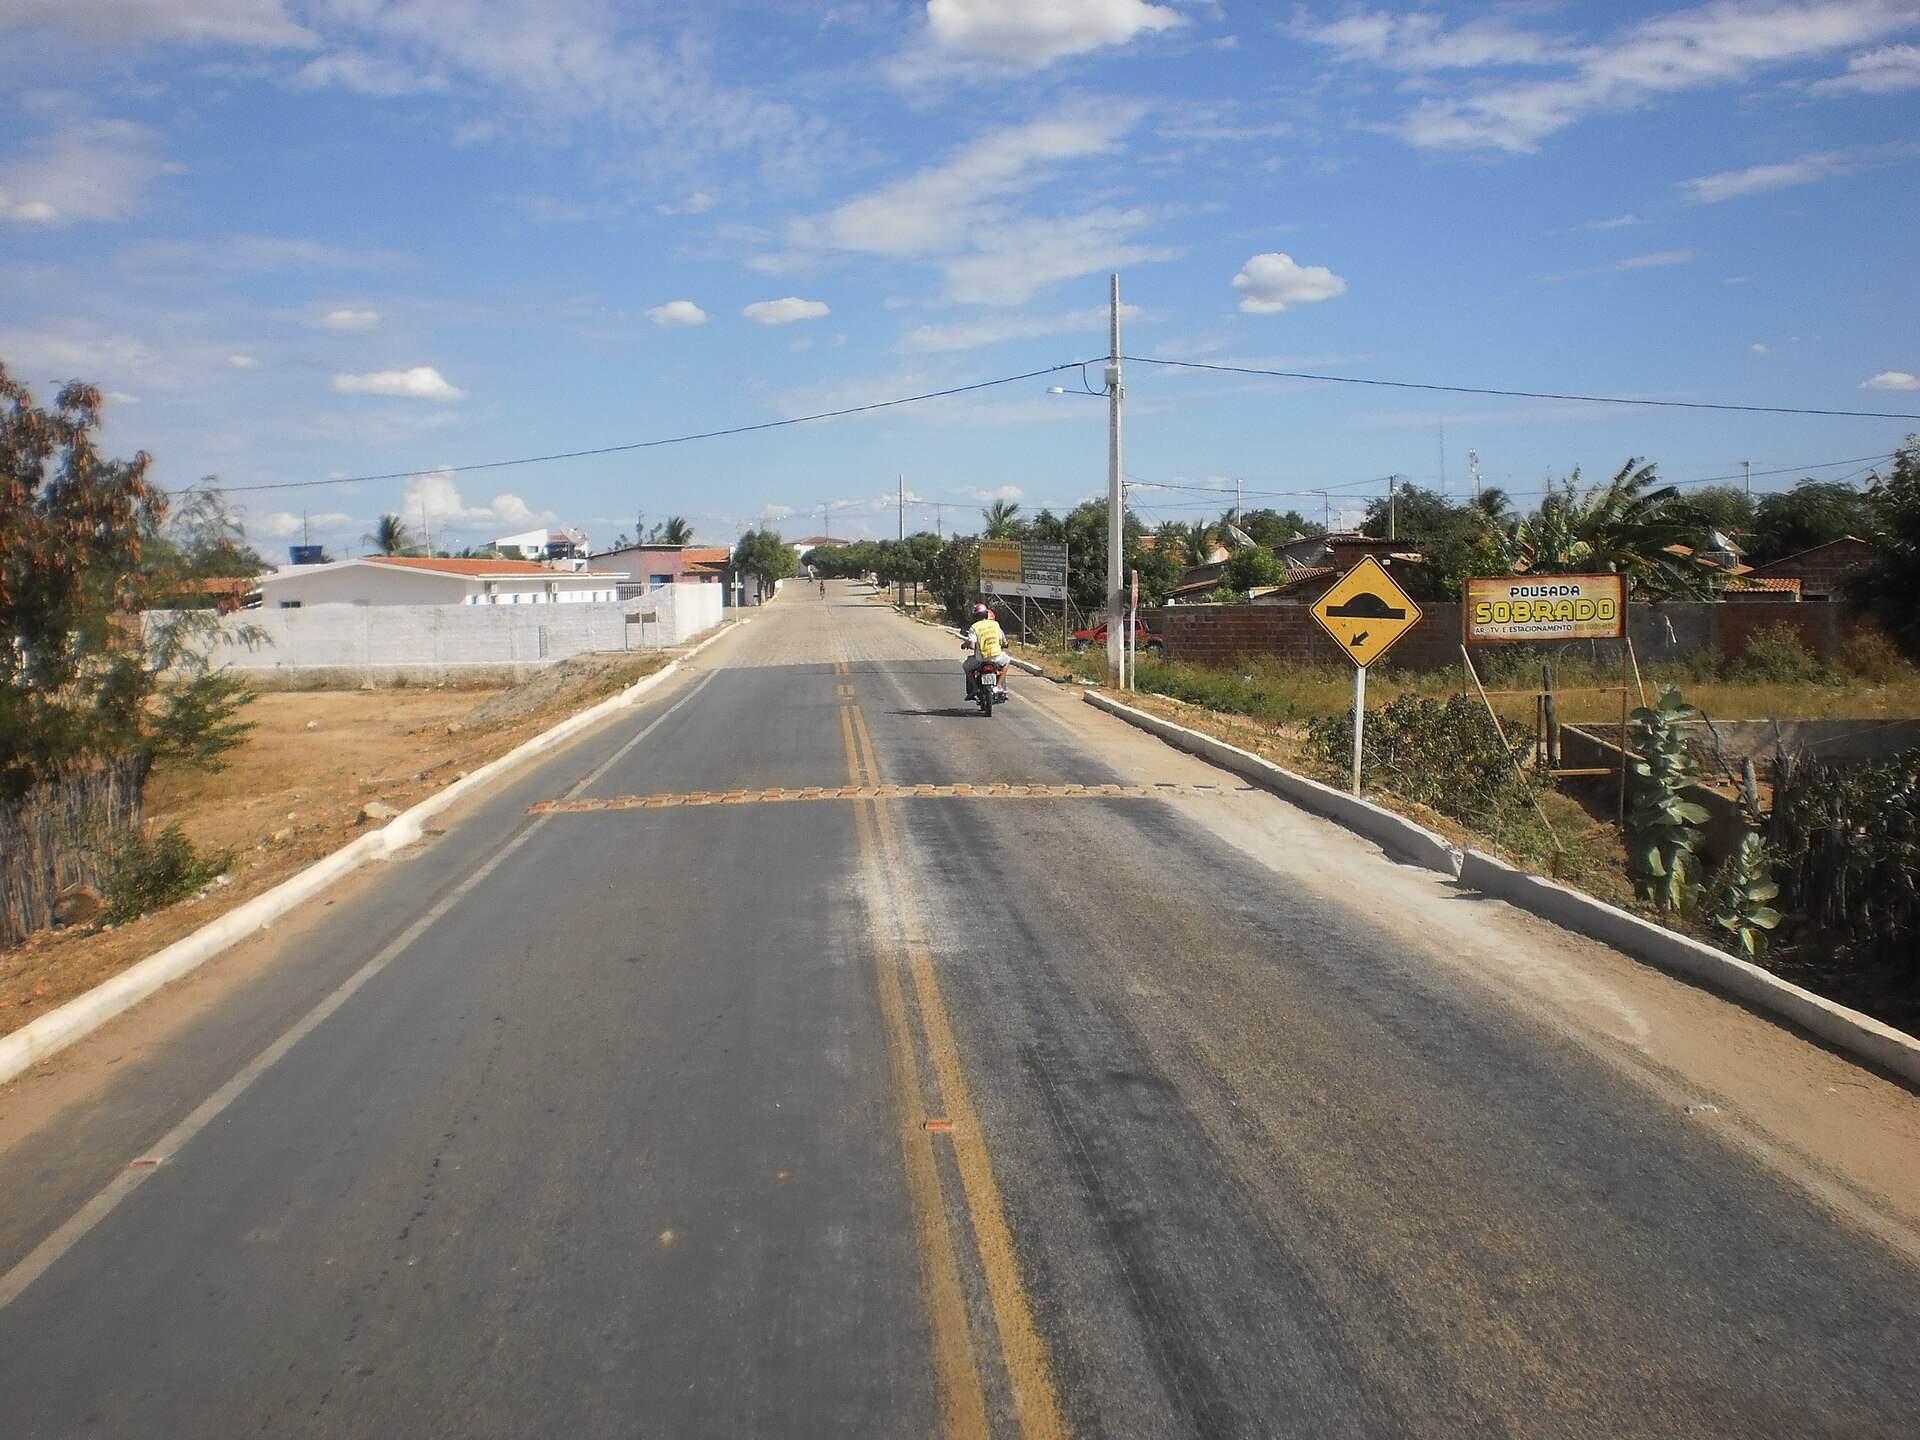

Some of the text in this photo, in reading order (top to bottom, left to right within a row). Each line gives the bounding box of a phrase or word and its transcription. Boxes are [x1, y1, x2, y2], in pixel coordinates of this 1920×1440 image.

[1026, 573, 1061, 582] BRASIL
[1510, 585, 1580, 597] POUSADA
[1475, 598, 1616, 624] SOBRADO
[1509, 624, 1573, 633] ESTACIONAMENTO
